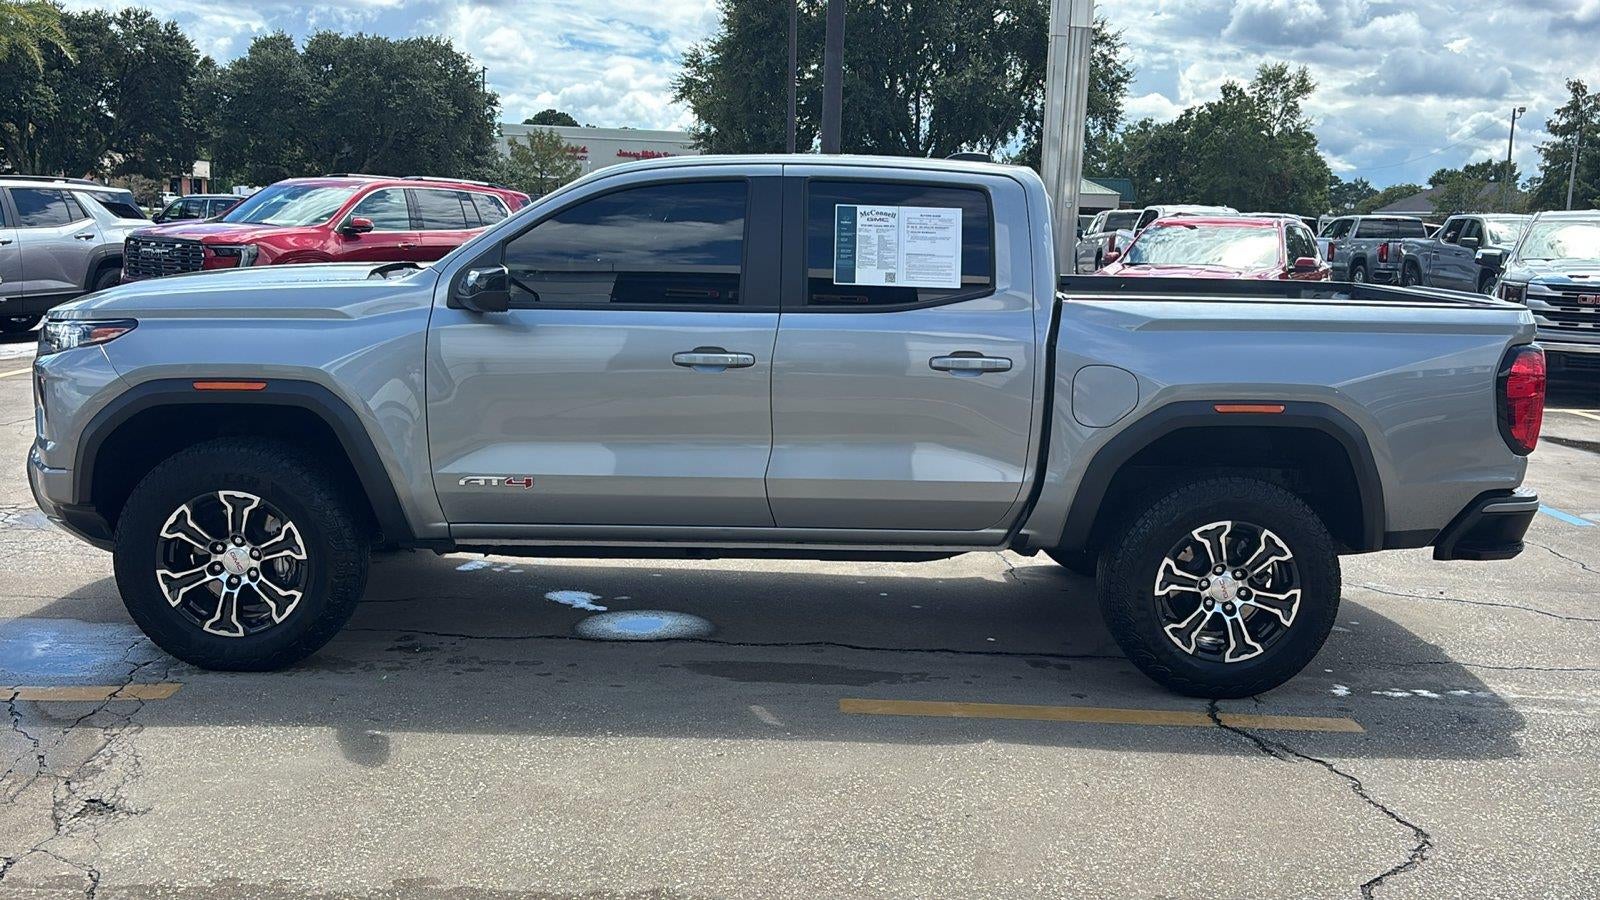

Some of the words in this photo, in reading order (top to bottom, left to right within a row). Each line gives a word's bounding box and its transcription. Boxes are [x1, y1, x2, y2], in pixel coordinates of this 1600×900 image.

[860, 209, 897, 219] McConnell
[458, 476, 534, 490] AT4
[230, 551, 244, 572] GMC
[1218, 579, 1229, 599] GMC
